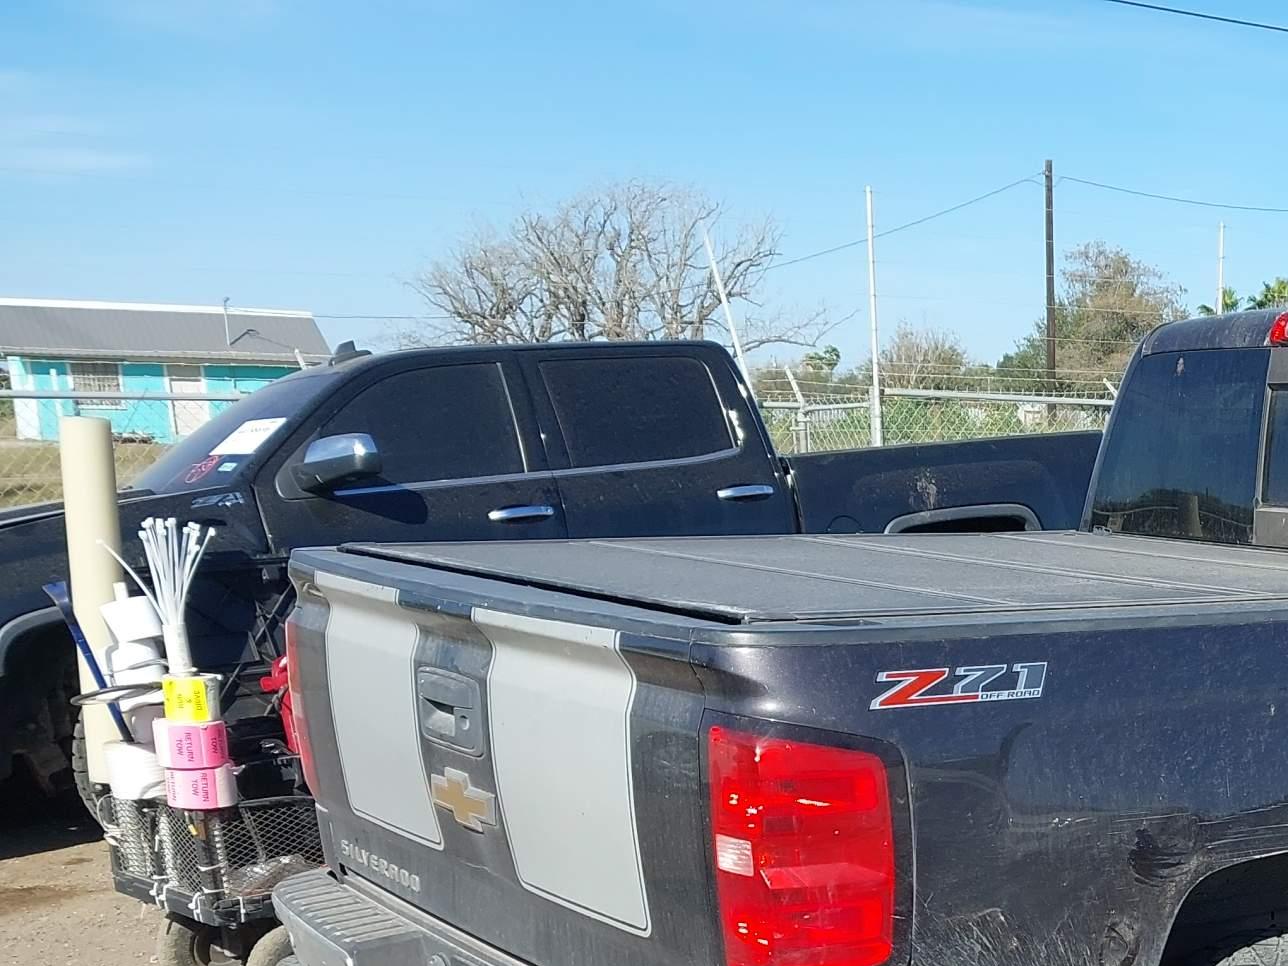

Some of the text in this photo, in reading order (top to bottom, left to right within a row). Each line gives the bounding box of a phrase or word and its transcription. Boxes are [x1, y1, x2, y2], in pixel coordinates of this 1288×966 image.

[869, 661, 1048, 711] Z71
[980, 689, 1040, 700] OFF ROAD
[175, 739, 185, 757] TOW
[184, 732, 195, 763] RETURN
[191, 779, 200, 797] TOW
[200, 772, 210, 802] RETURN
[341, 839, 420, 893] SILVERADO
